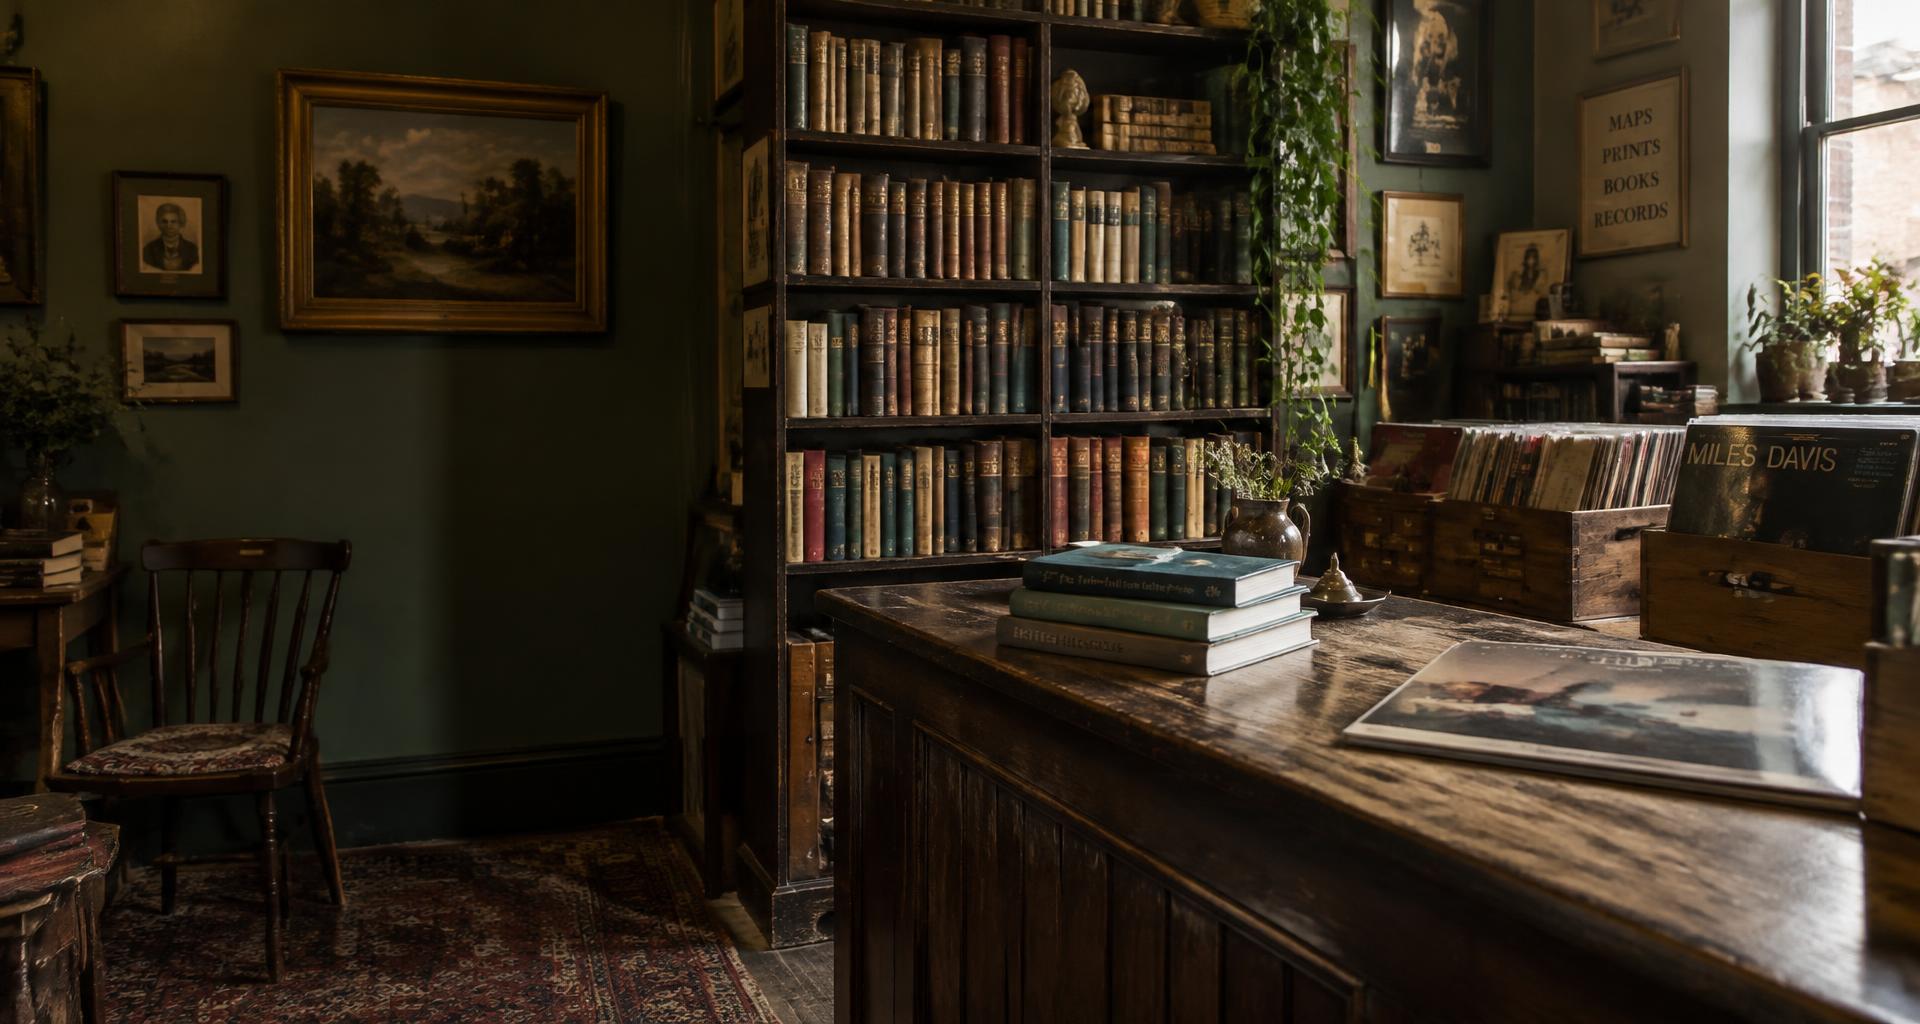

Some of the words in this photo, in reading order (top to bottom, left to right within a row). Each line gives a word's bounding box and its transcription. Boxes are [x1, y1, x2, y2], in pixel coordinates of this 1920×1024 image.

[1608, 107, 1653, 132] MAPS
[1602, 138, 1661, 164] PRINTS
[1604, 171, 1660, 195] BOOKS
[1594, 202, 1669, 228] RECORDS
[1687, 442, 1758, 468] MILES
[1767, 445, 1838, 472] DAVIS
